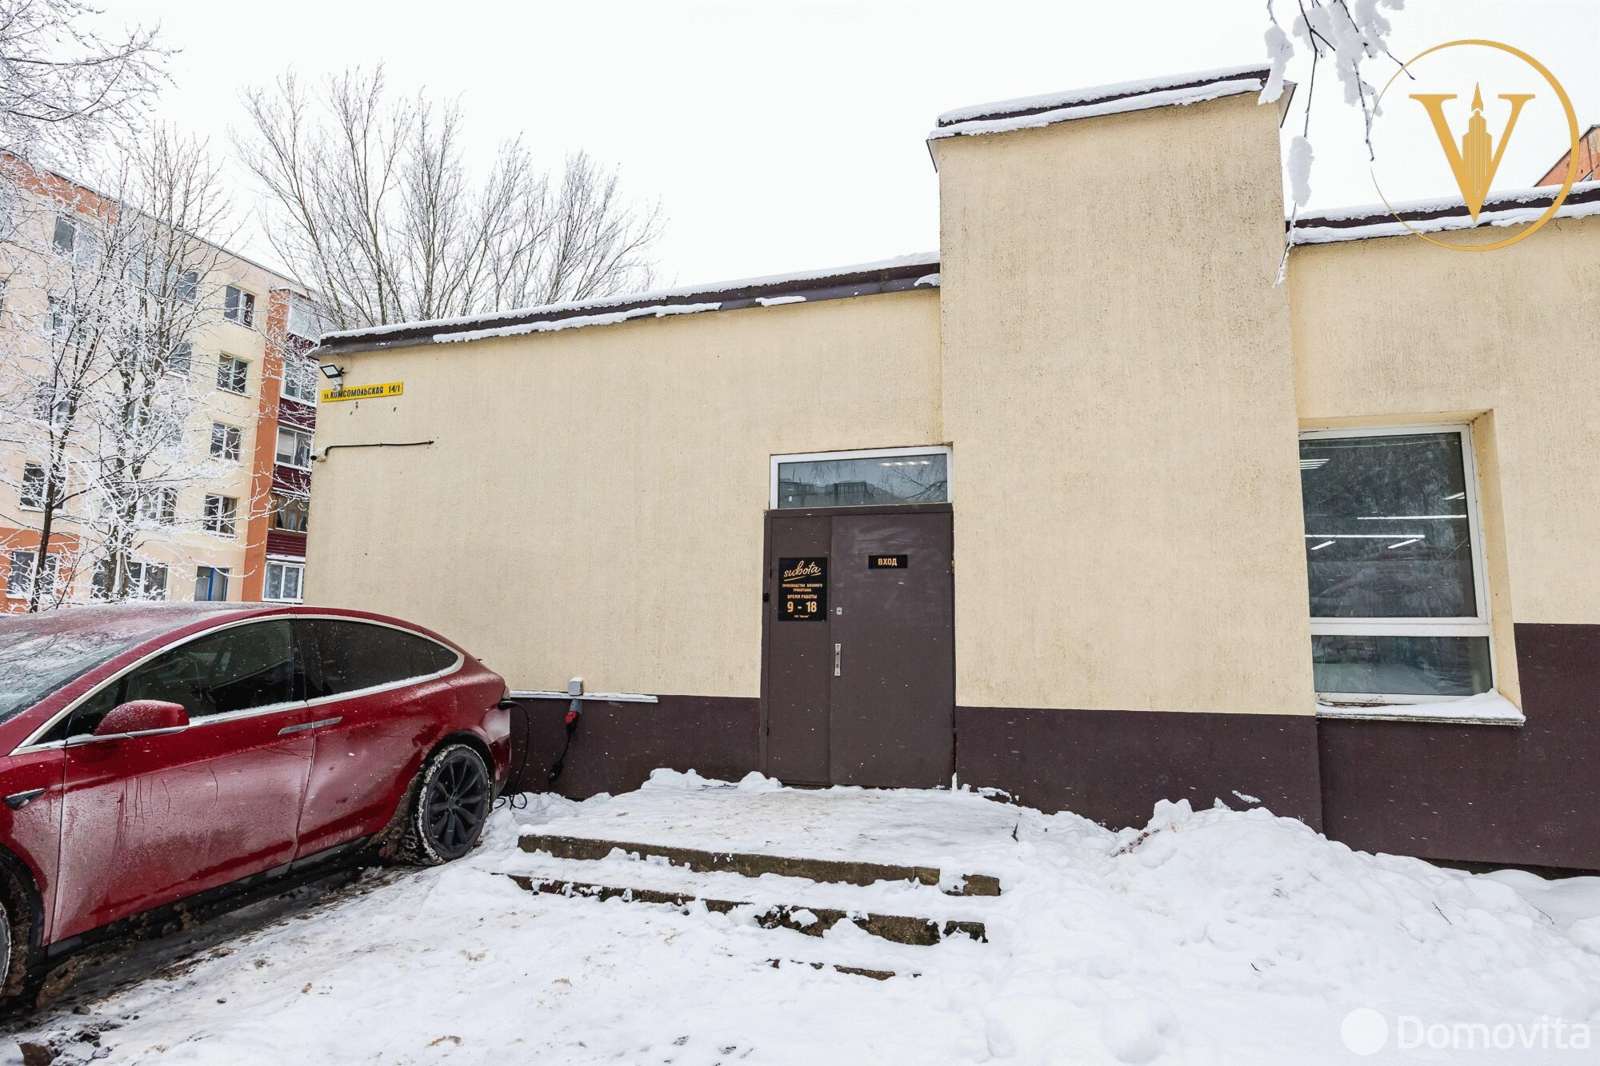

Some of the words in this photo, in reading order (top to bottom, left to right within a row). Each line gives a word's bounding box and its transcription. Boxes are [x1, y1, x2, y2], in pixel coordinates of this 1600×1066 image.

[330, 386, 384, 399] КОМСОМОЛЬСКАЯ
[388, 384, 400, 393] 14/1
[877, 557, 898, 567] ВХОД
[783, 560, 822, 578] subota
[787, 601, 794, 613] 9
[805, 601, 818, 613] 18
